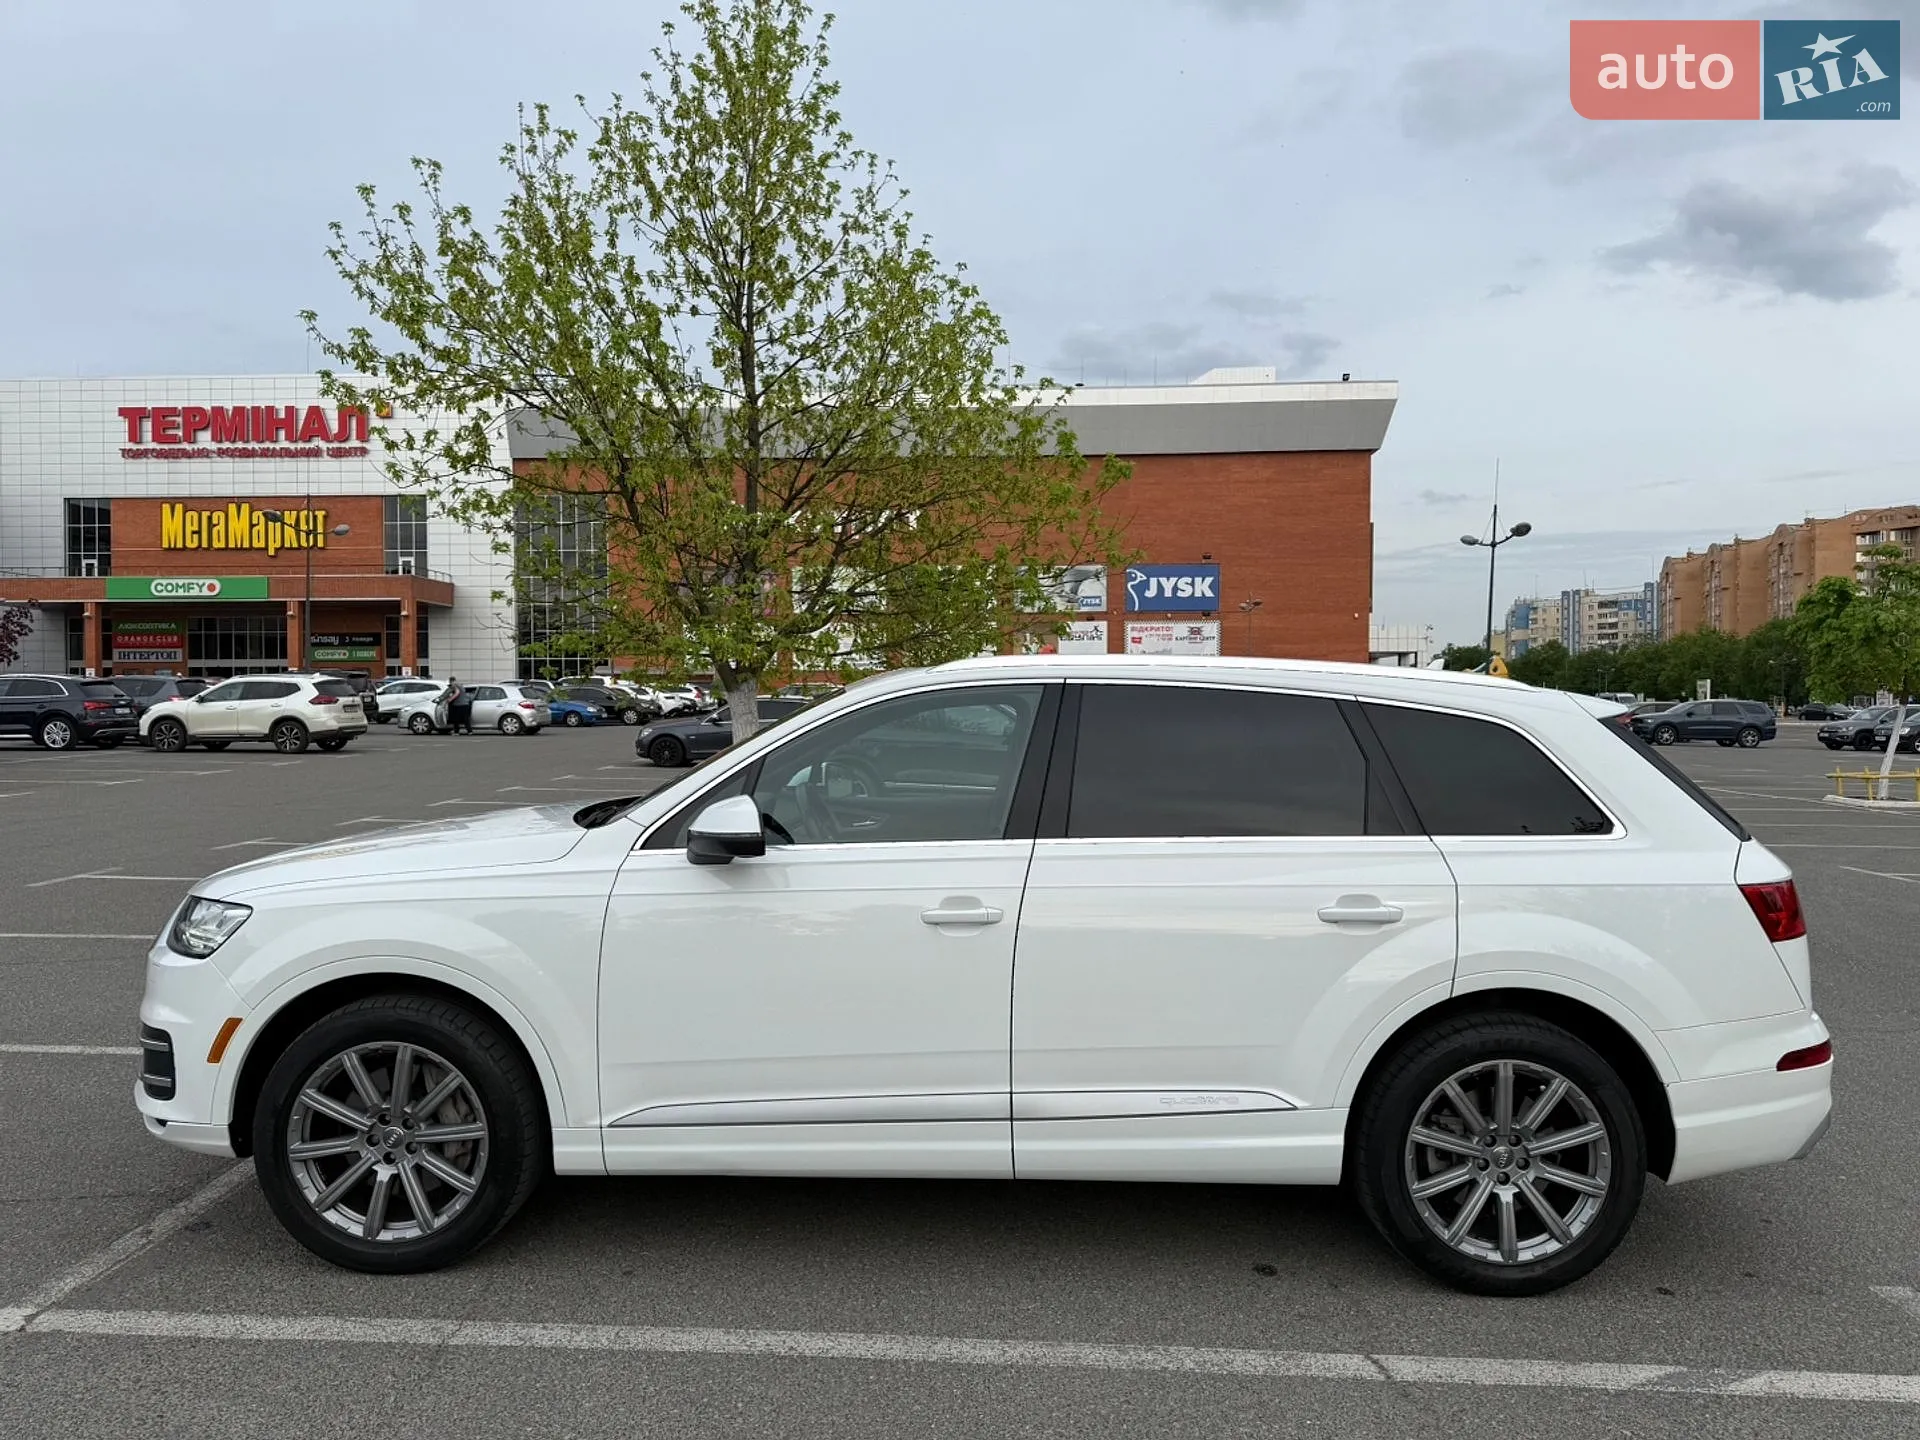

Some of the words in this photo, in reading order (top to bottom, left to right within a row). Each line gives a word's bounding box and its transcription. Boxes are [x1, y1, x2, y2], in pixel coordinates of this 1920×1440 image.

[118, 405, 370, 443] ТЕРМІНАЛ
[161, 501, 328, 557] МегаМаркет
[154, 583, 205, 593] COMFY
[1144, 576, 1215, 598] JYSK
[118, 651, 177, 659] ІНТЕРТОП
